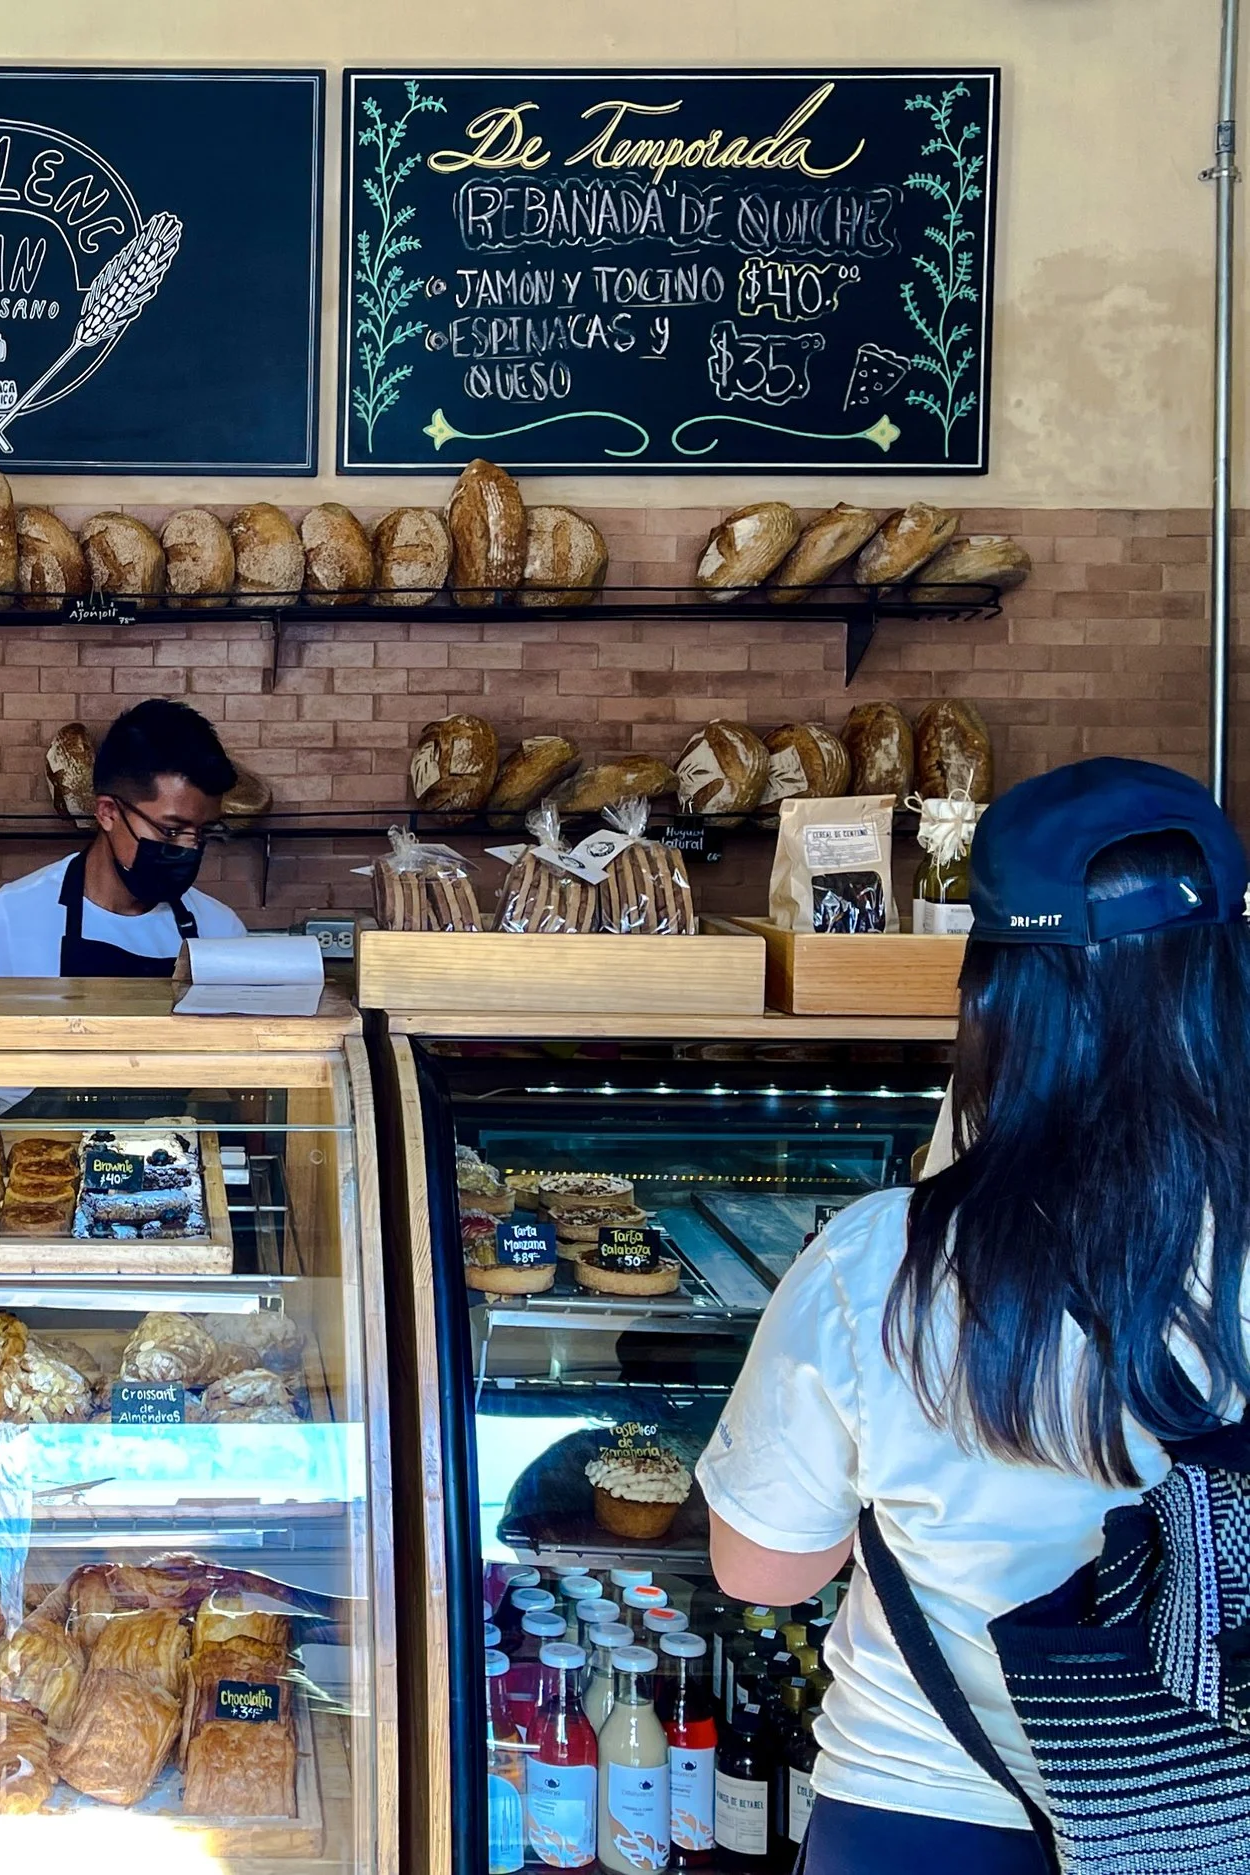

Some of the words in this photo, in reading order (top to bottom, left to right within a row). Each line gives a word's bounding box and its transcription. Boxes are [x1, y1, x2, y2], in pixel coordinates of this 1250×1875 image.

[428, 101, 552, 174] De
[565, 82, 865, 185] Temporada
[467, 183, 665, 239] REBANADA
[679, 193, 723, 240] DE
[737, 191, 880, 250] QUICHE
[592, 266, 725, 305] TOCINO
[452, 313, 637, 358] ESPINACAS
[464, 360, 572, 399] QUESO
[1010, 914, 1062, 927] DRI-FIT
[94, 1160, 133, 1173] Brownie
[512, 1225, 538, 1237] Tarta
[504, 1239, 547, 1252] Manzana
[122, 1385, 176, 1401] Croissant
[140, 1404, 154, 1413] de
[118, 1410, 180, 1423] Almendras
[618, 1438, 633, 1448] de
